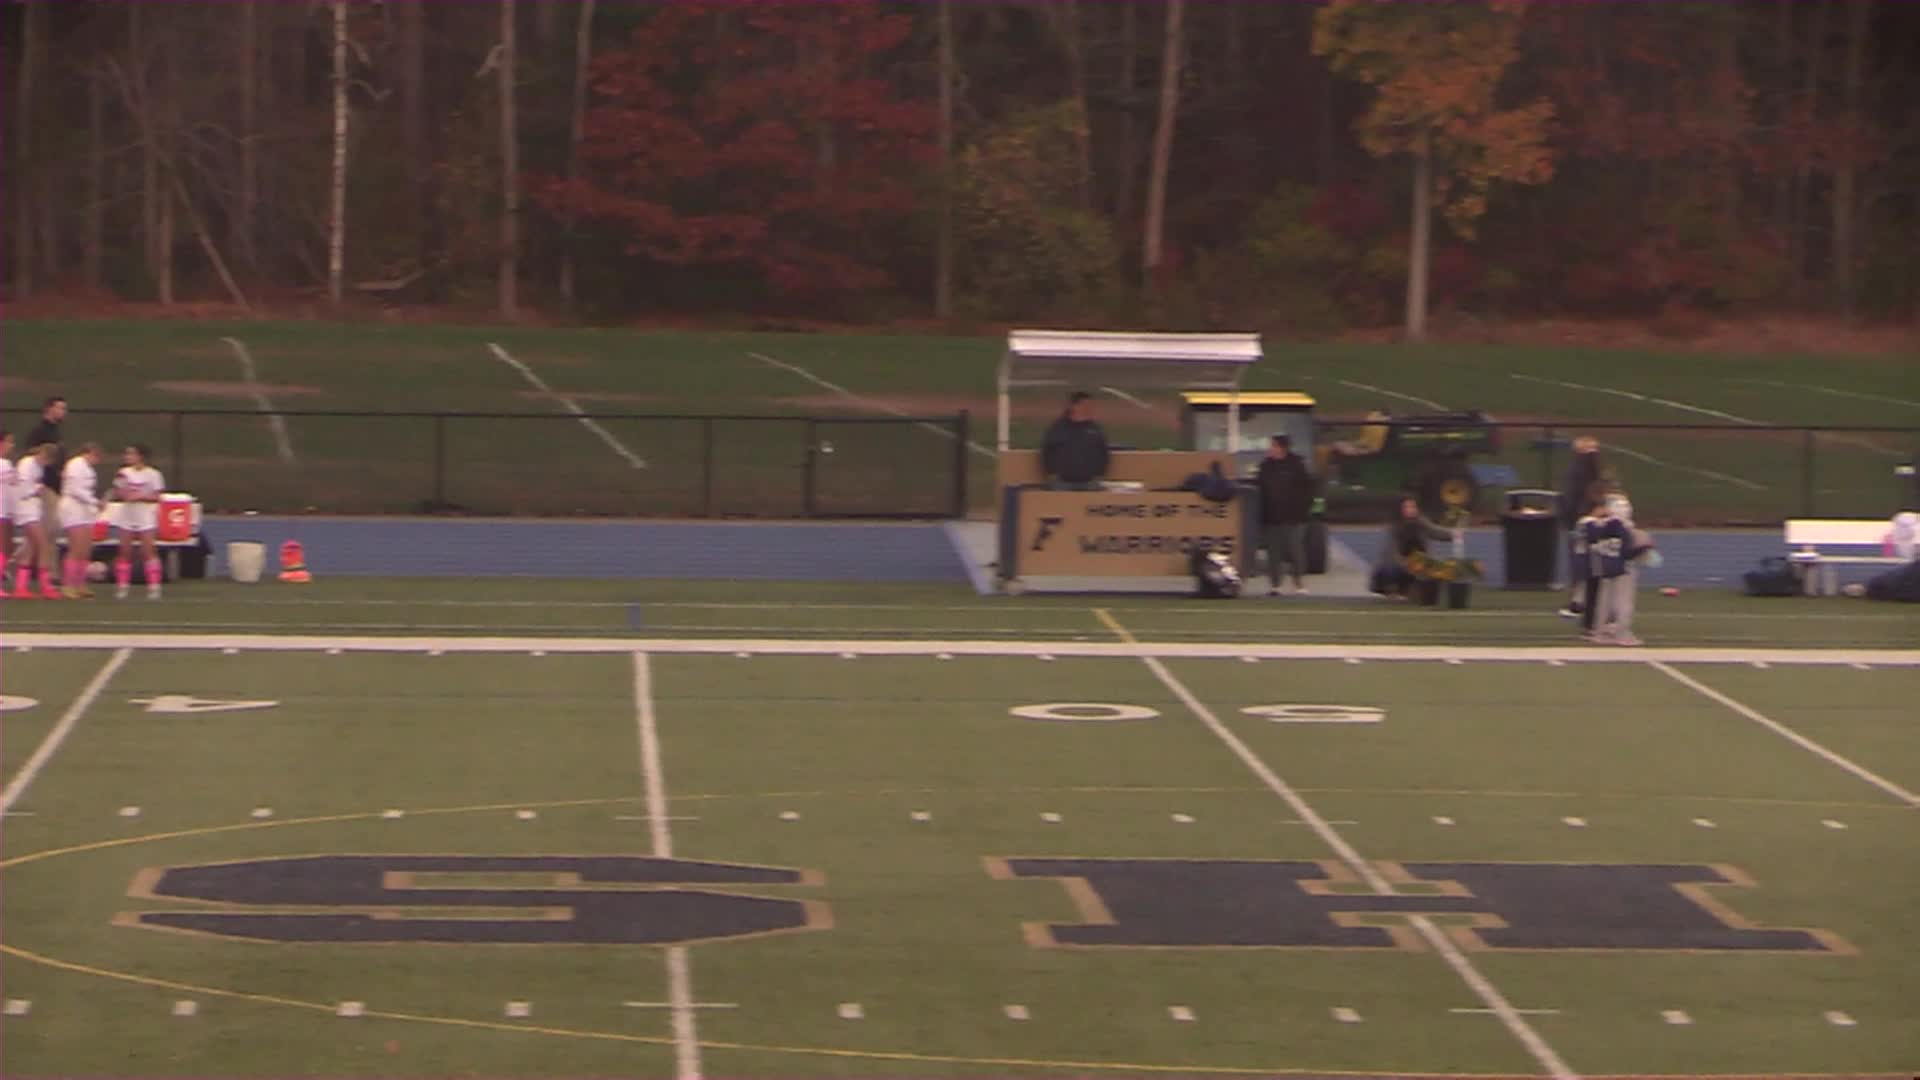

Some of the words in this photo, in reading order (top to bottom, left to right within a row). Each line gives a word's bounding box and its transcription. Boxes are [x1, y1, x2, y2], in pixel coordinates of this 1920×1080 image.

[1085, 504, 1146, 519] HOME
[1153, 504, 1181, 519] OF
[1186, 504, 1228, 519] THE
[1030, 517, 1064, 551] F
[1078, 536, 1235, 555] WARRIORS
